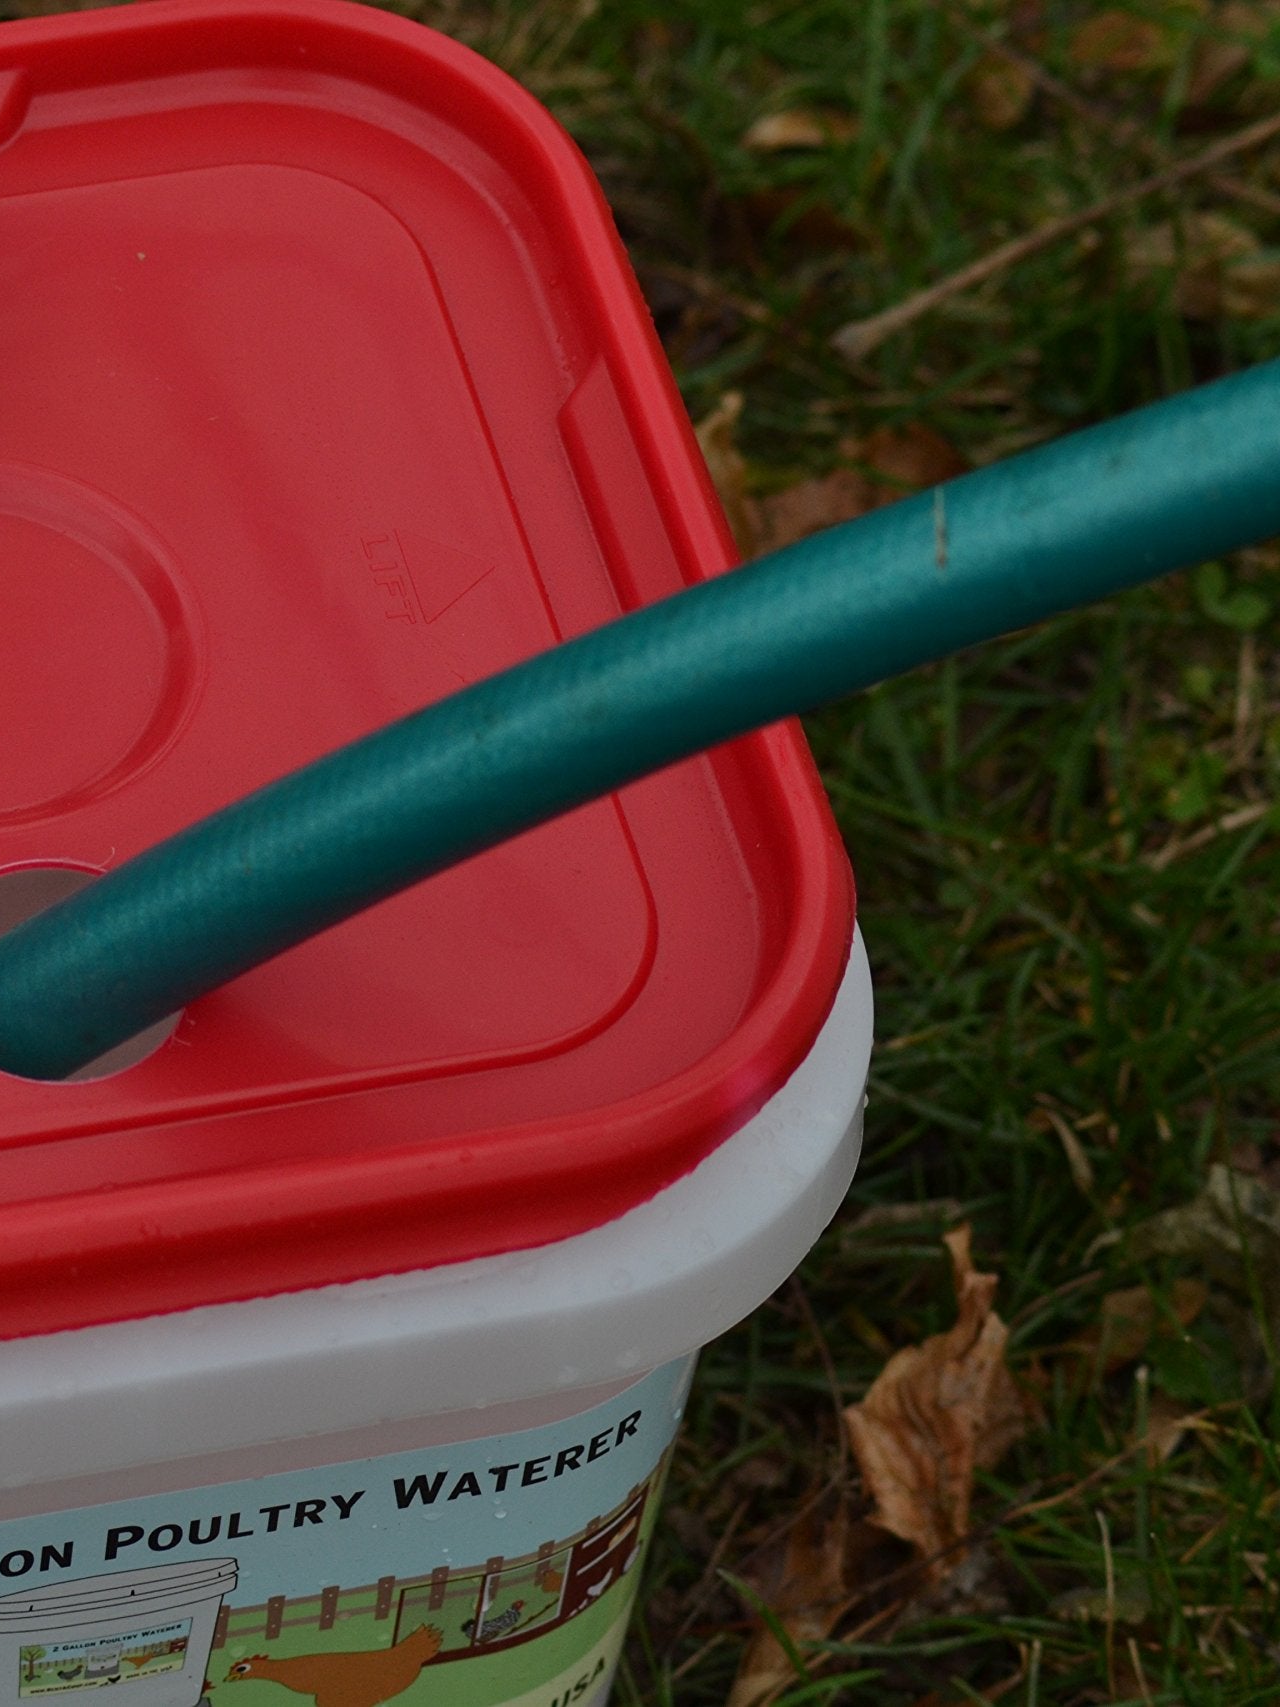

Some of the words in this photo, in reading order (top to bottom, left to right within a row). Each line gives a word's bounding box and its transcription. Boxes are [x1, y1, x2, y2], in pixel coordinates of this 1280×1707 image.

[104, 1490, 365, 1561] POULTRY
[392, 1410, 643, 1510] WATERER
[62, 1642, 96, 1651] GALLON
[99, 1633, 138, 1645] POULTRY
[141, 1623, 182, 1637] WATERER
